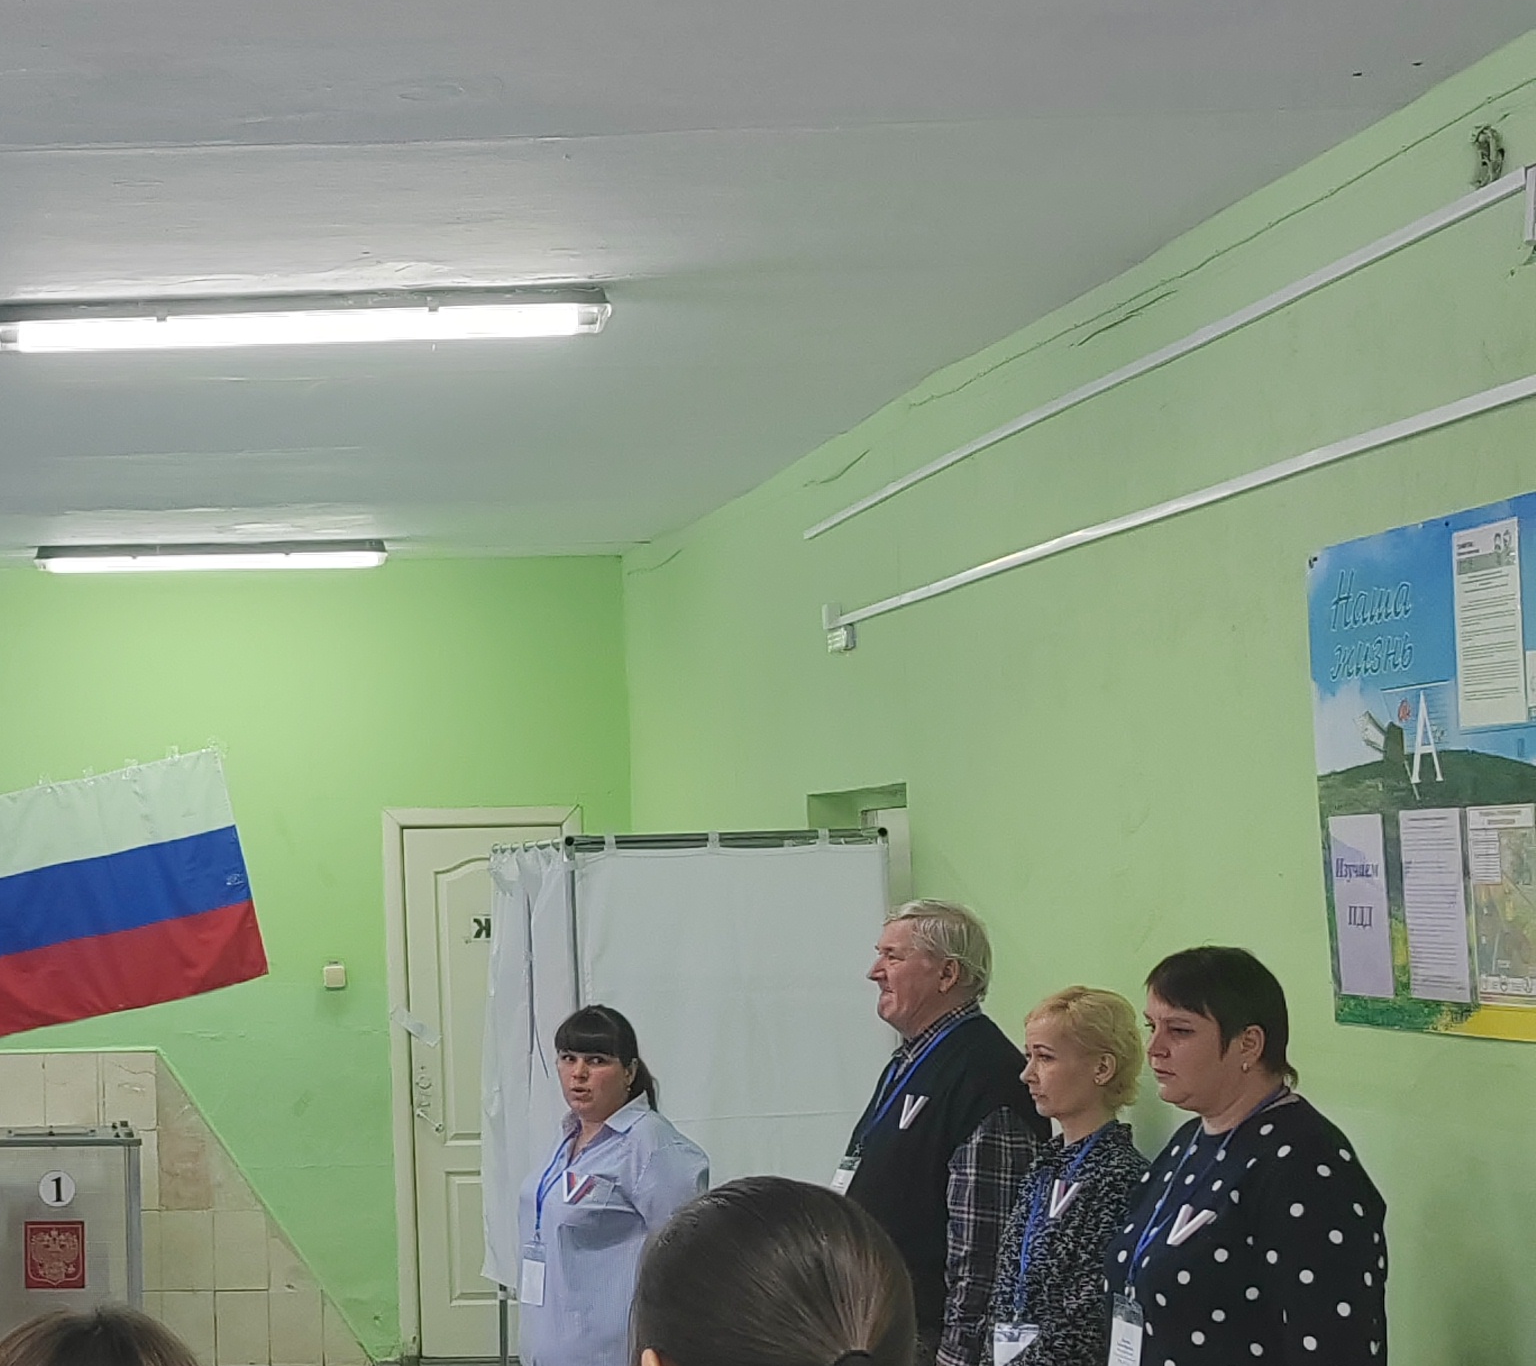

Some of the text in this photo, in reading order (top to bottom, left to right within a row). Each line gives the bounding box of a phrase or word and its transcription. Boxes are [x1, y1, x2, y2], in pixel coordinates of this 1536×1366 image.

[1330, 568, 1412, 632] Наша
[1329, 632, 1414, 682] жизнь
[1335, 857, 1379, 883] Изучаем
[1347, 905, 1374, 929] ПДД
[50, 1176, 65, 1203] 1
